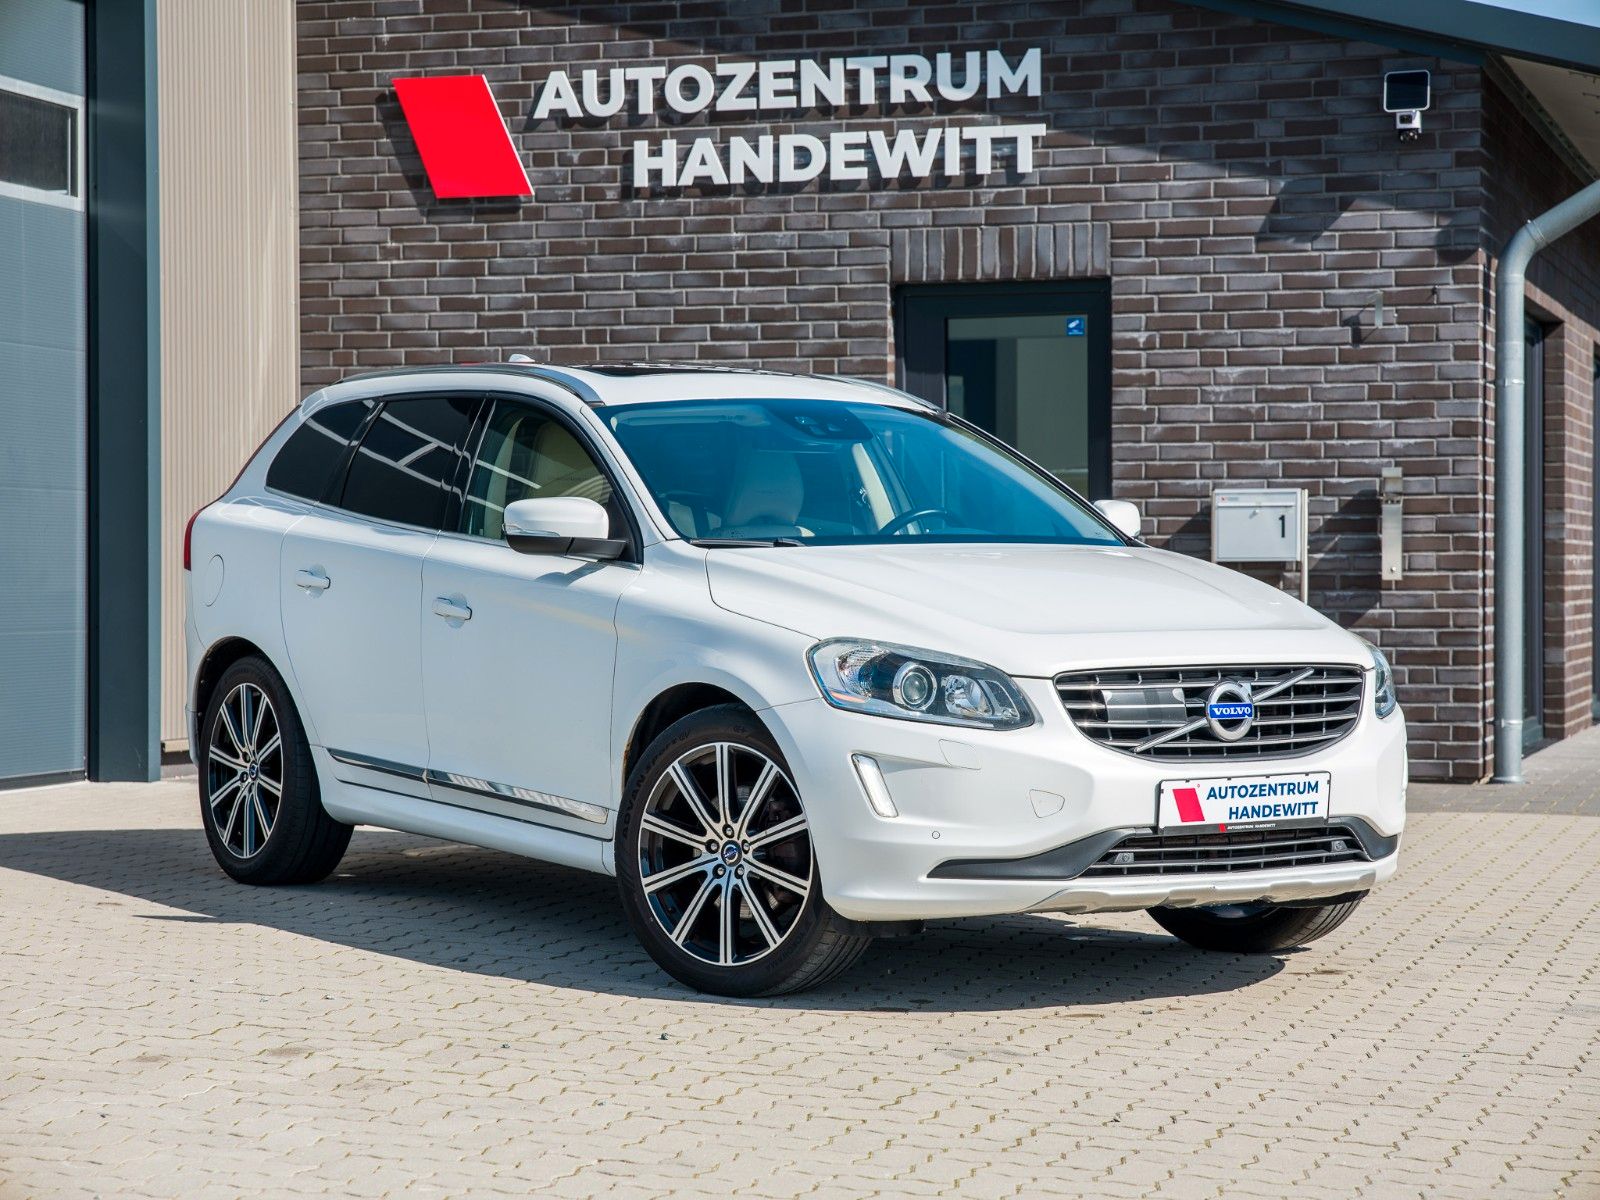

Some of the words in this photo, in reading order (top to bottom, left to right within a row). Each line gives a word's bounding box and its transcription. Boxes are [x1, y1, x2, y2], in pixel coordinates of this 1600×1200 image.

[533, 48, 1042, 119] AUTOZENTRUM
[633, 123, 1046, 188] HANDEWITT
[1278, 514, 1286, 538] 1
[1212, 706, 1251, 715] VOLVO
[1207, 781, 1318, 800] AUTOZENTRUM
[1229, 802, 1318, 820] HANDEWITT
